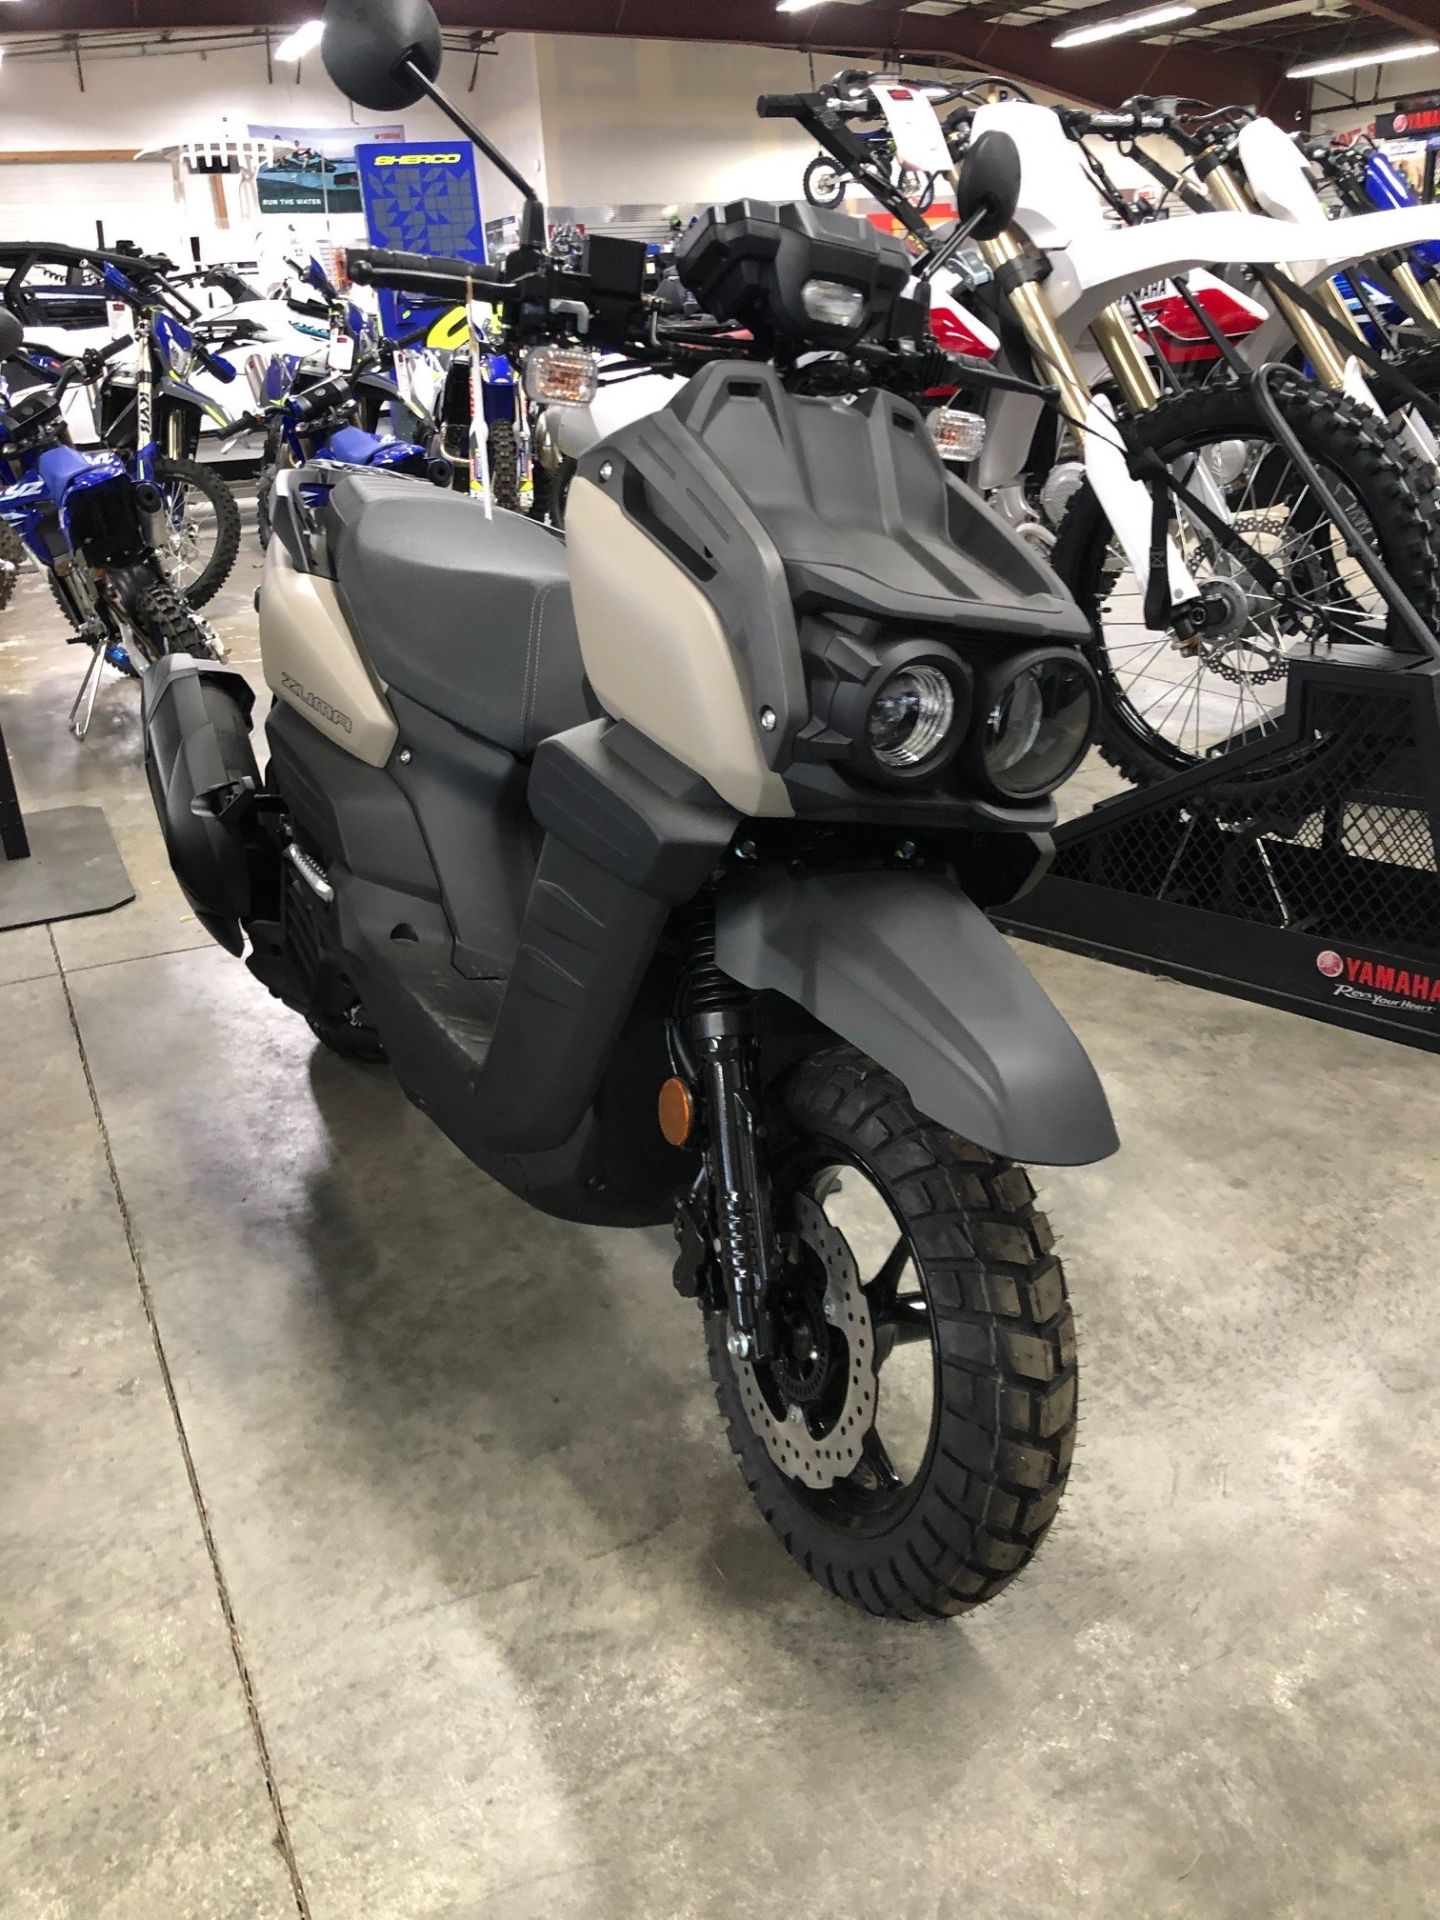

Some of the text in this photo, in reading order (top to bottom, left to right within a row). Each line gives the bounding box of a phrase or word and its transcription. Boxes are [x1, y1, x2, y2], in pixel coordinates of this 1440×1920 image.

[374, 153, 462, 166] SHERCO
[280, 198, 295, 206] THE
[296, 198, 322, 206] WATER
[281, 671, 353, 734] ZUMA
[1333, 983, 1433, 1013] Revs Your Heart
